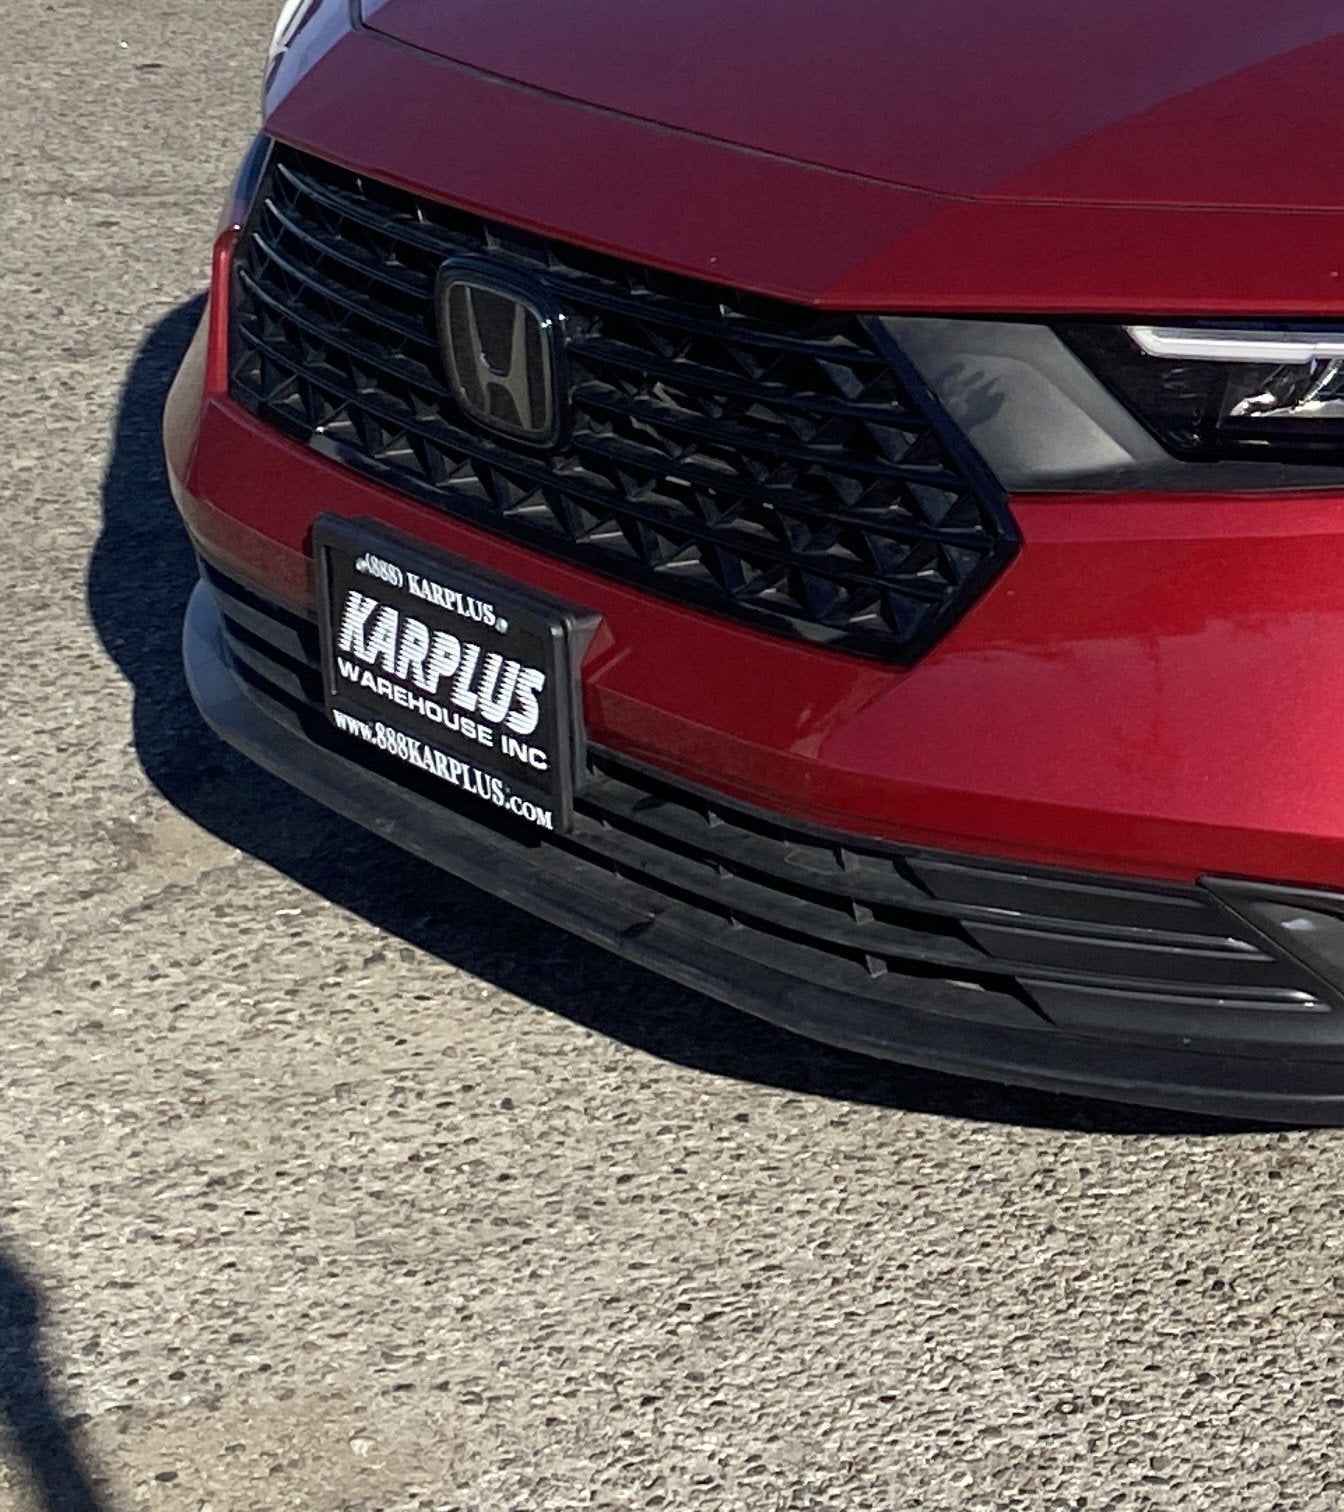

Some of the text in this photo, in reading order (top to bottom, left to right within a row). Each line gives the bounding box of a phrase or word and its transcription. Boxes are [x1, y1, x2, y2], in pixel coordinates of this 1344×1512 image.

[406, 571, 497, 627] KARPLUS
[337, 590, 547, 736] KARPLUS
[337, 656, 549, 771] WAREHOUSE INC
